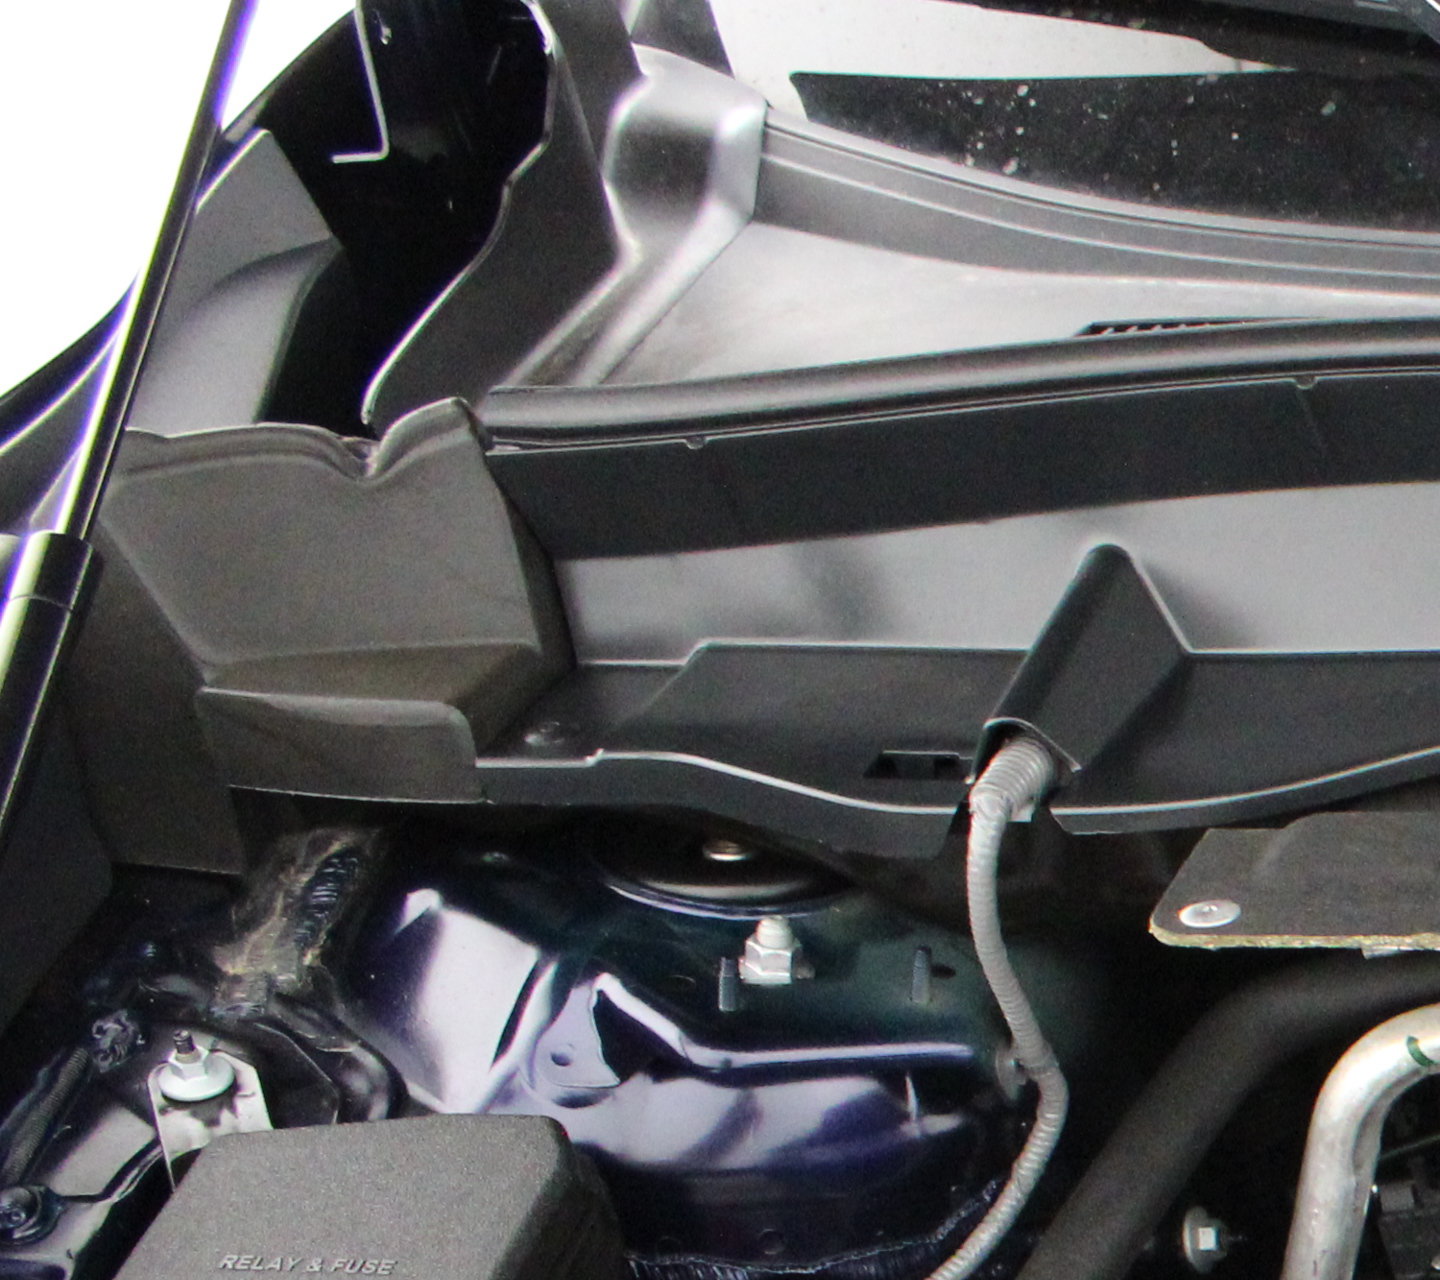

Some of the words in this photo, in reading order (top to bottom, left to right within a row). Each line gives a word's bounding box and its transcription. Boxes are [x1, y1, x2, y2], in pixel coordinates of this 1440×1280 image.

[218, 1254, 303, 1272] RELAY
[305, 1257, 324, 1272] &
[330, 1258, 398, 1275] FUSE
